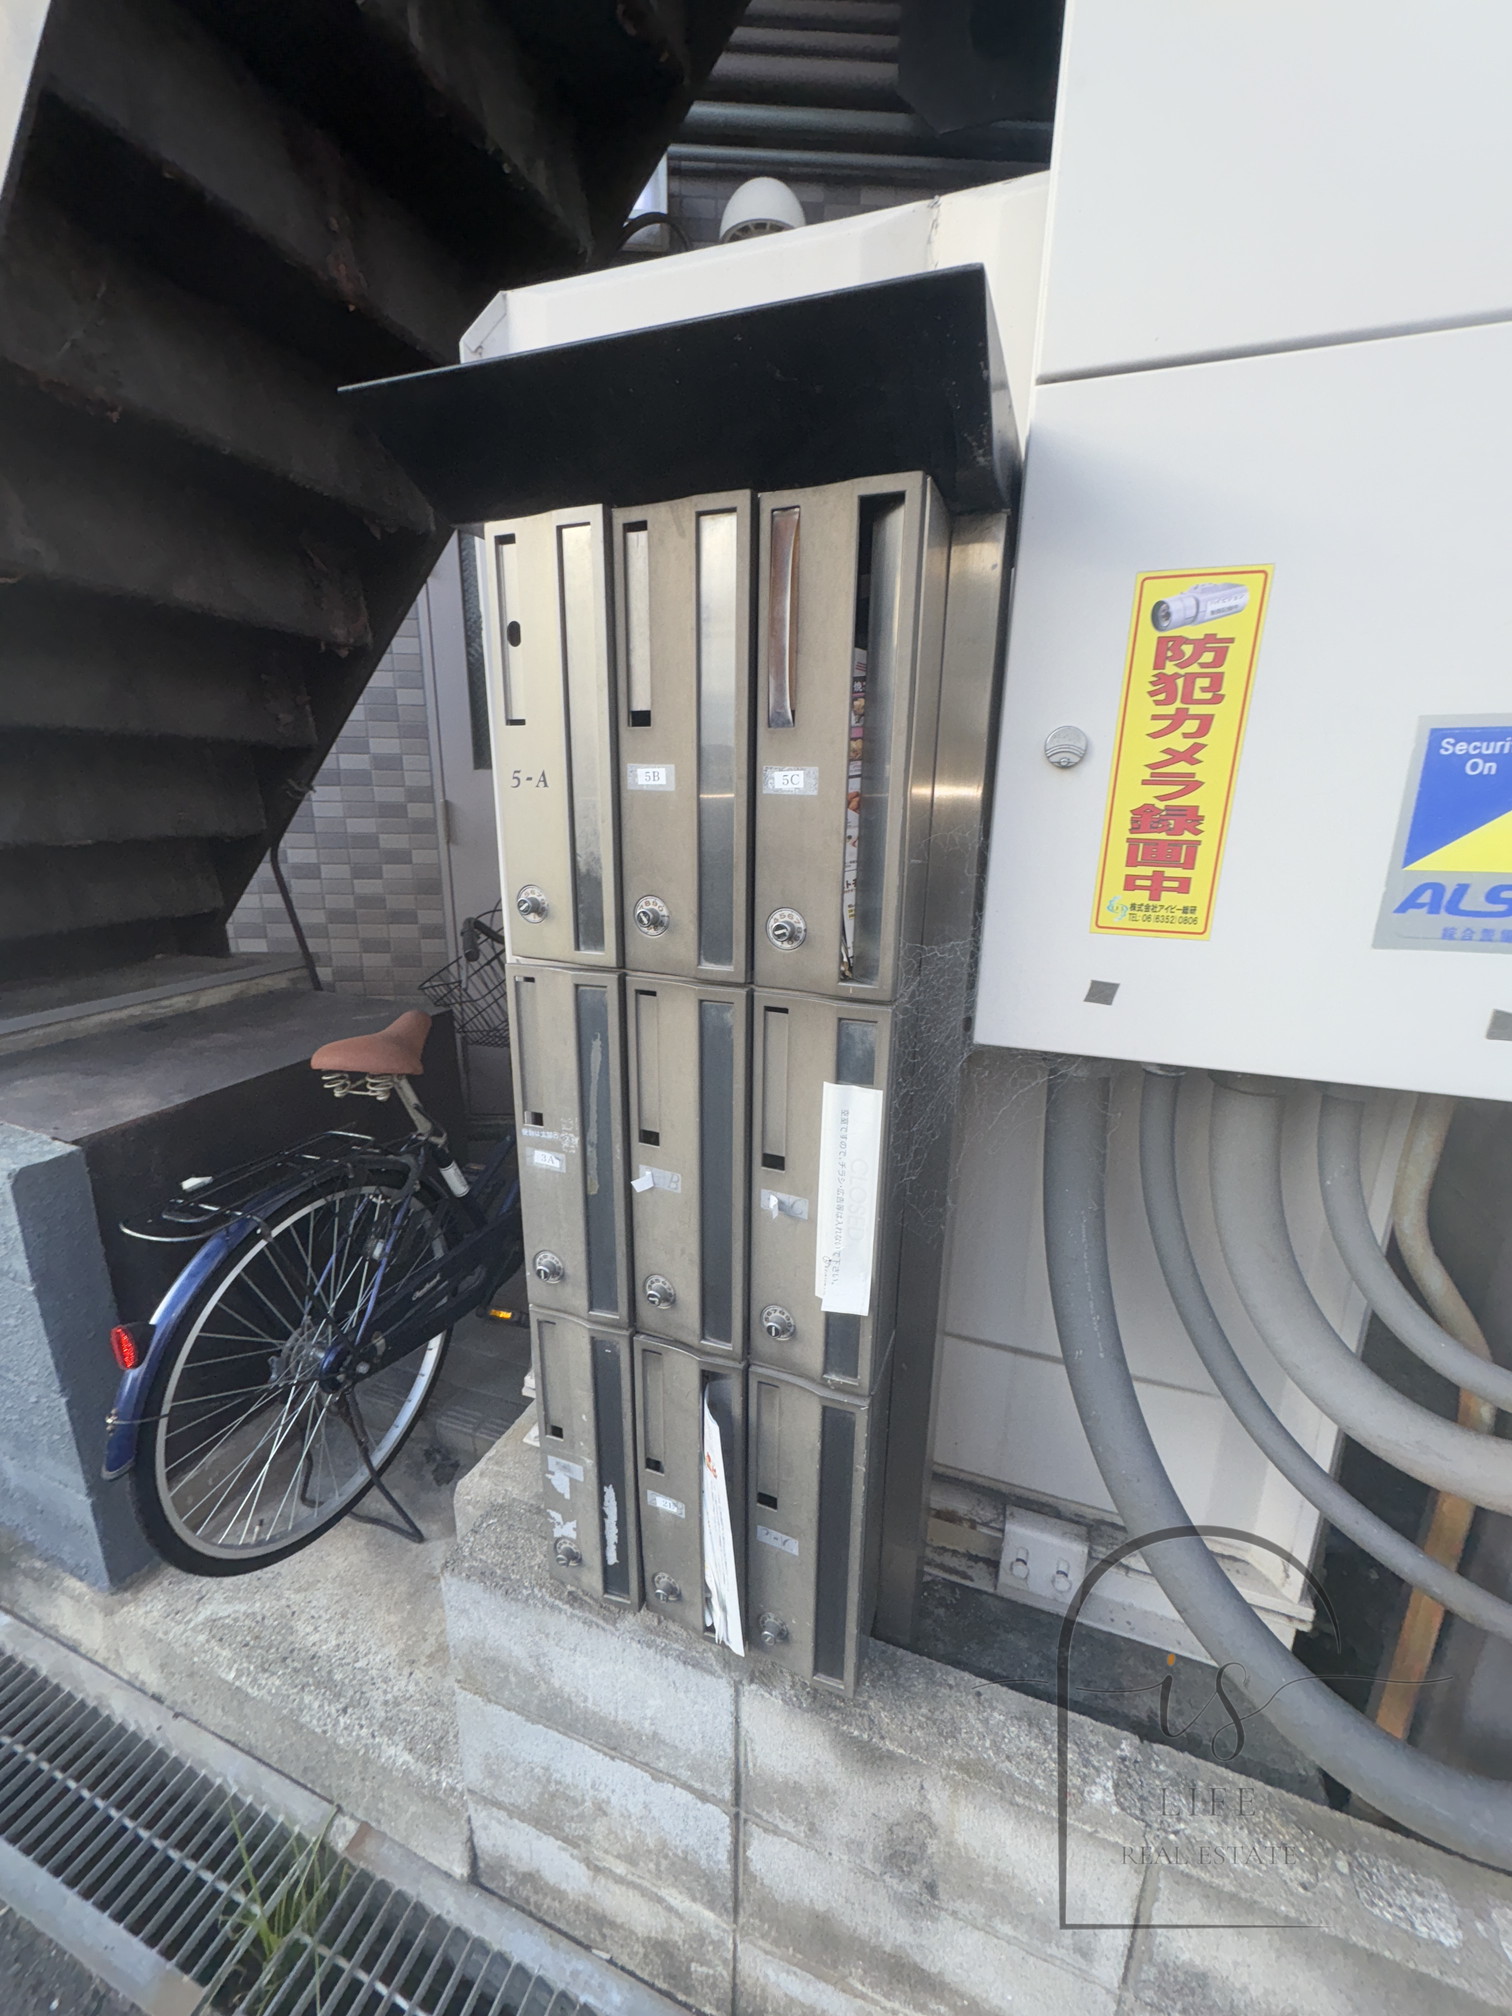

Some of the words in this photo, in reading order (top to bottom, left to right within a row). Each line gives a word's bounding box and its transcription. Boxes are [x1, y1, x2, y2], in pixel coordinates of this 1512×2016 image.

[1439, 737, 1512, 755] Securi
[1122, 633, 1235, 902] 防犯カメラ録画中
[1465, 758, 1497, 775] On
[510, 769, 549, 788] 5-A
[644, 770, 660, 782] 5B
[782, 773, 800, 786] 5C
[540, 1153, 555, 1165] 3A
[847, 1158, 869, 1241] CLOSED
